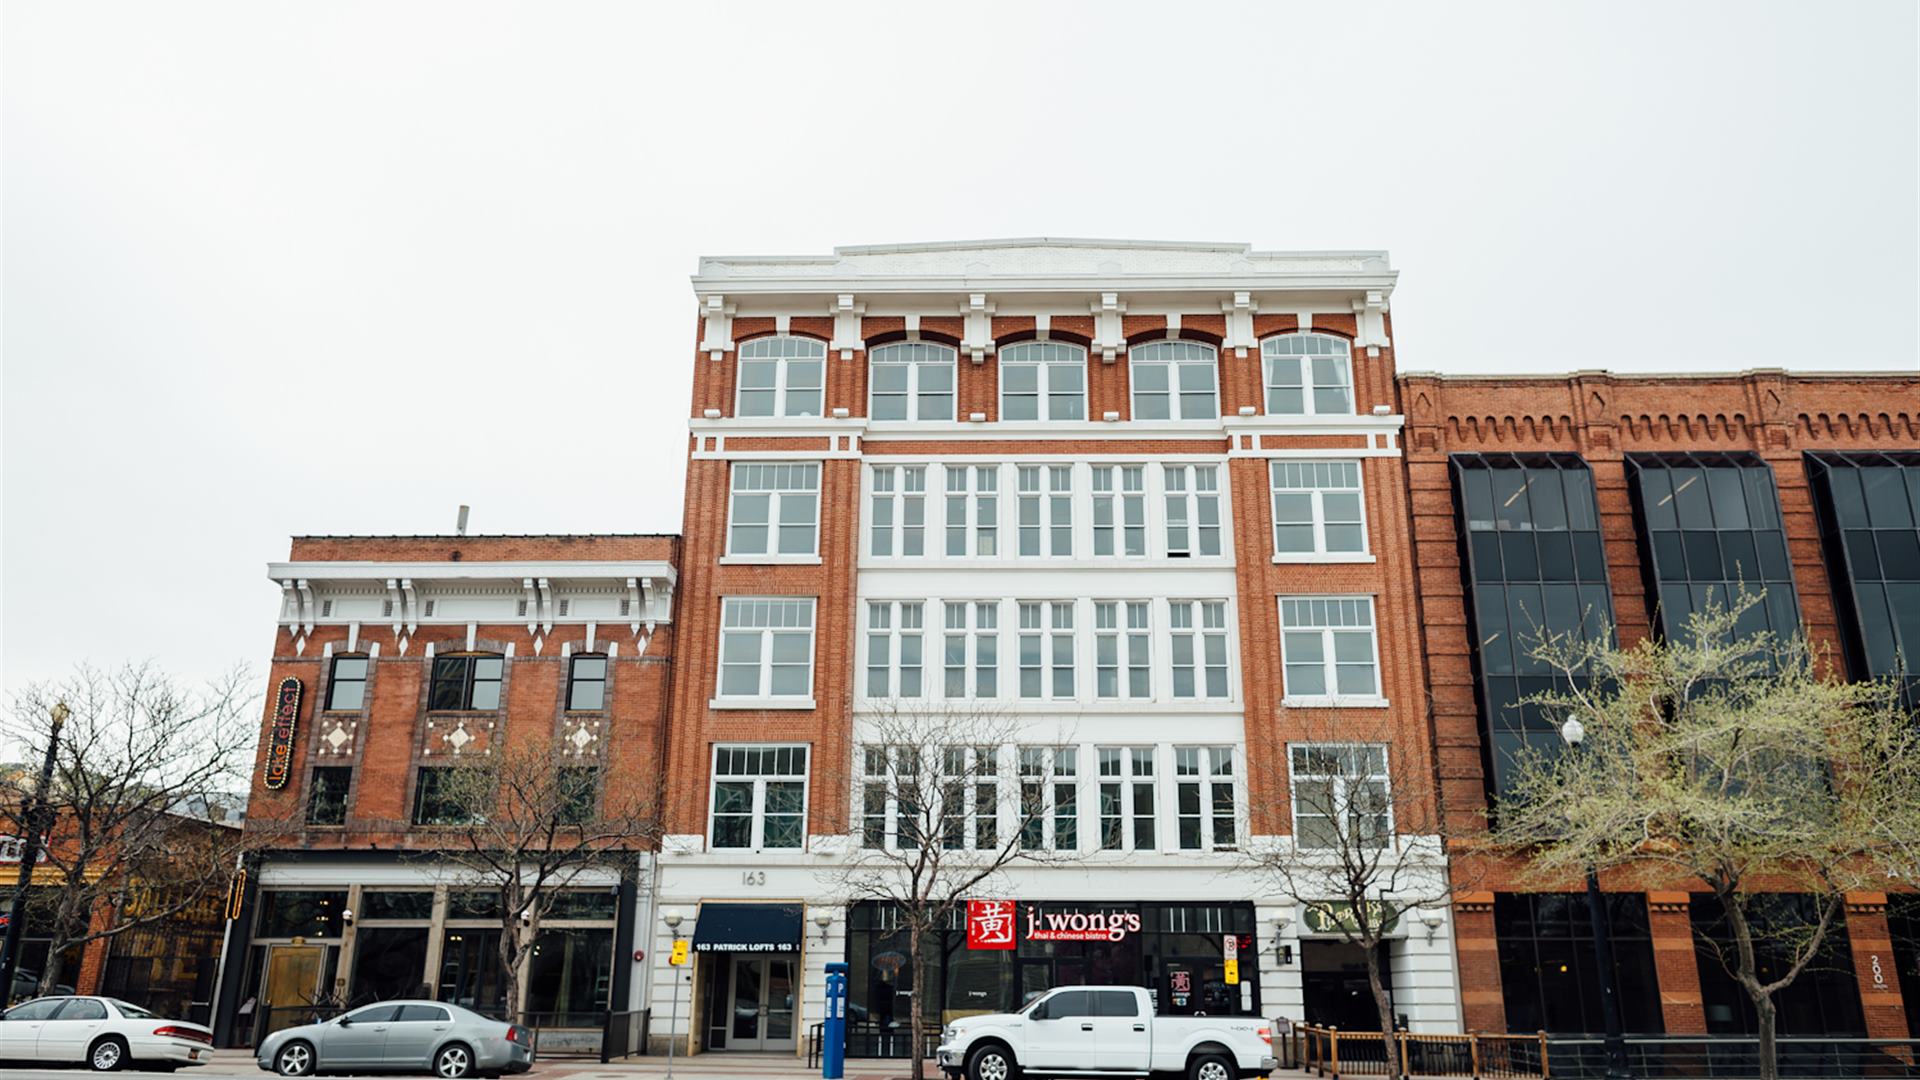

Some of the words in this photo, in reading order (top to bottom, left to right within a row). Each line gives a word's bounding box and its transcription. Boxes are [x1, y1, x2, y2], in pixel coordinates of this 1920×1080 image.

[277, 687, 296, 739] effect
[268, 744, 287, 781] lake
[742, 871, 766, 886] 163
[1034, 932, 1049, 940] thai
[1050, 932, 1055, 940] &
[1056, 931, 1084, 940] chinese
[1085, 931, 1107, 940] bistro
[1045, 913, 1141, 942] wong's
[696, 943, 711, 951] 163
[713, 943, 748, 951] PATRICK
[749, 943, 775, 951] LOFTS
[777, 943, 792, 951] 163
[1871, 954, 1884, 984] 200
